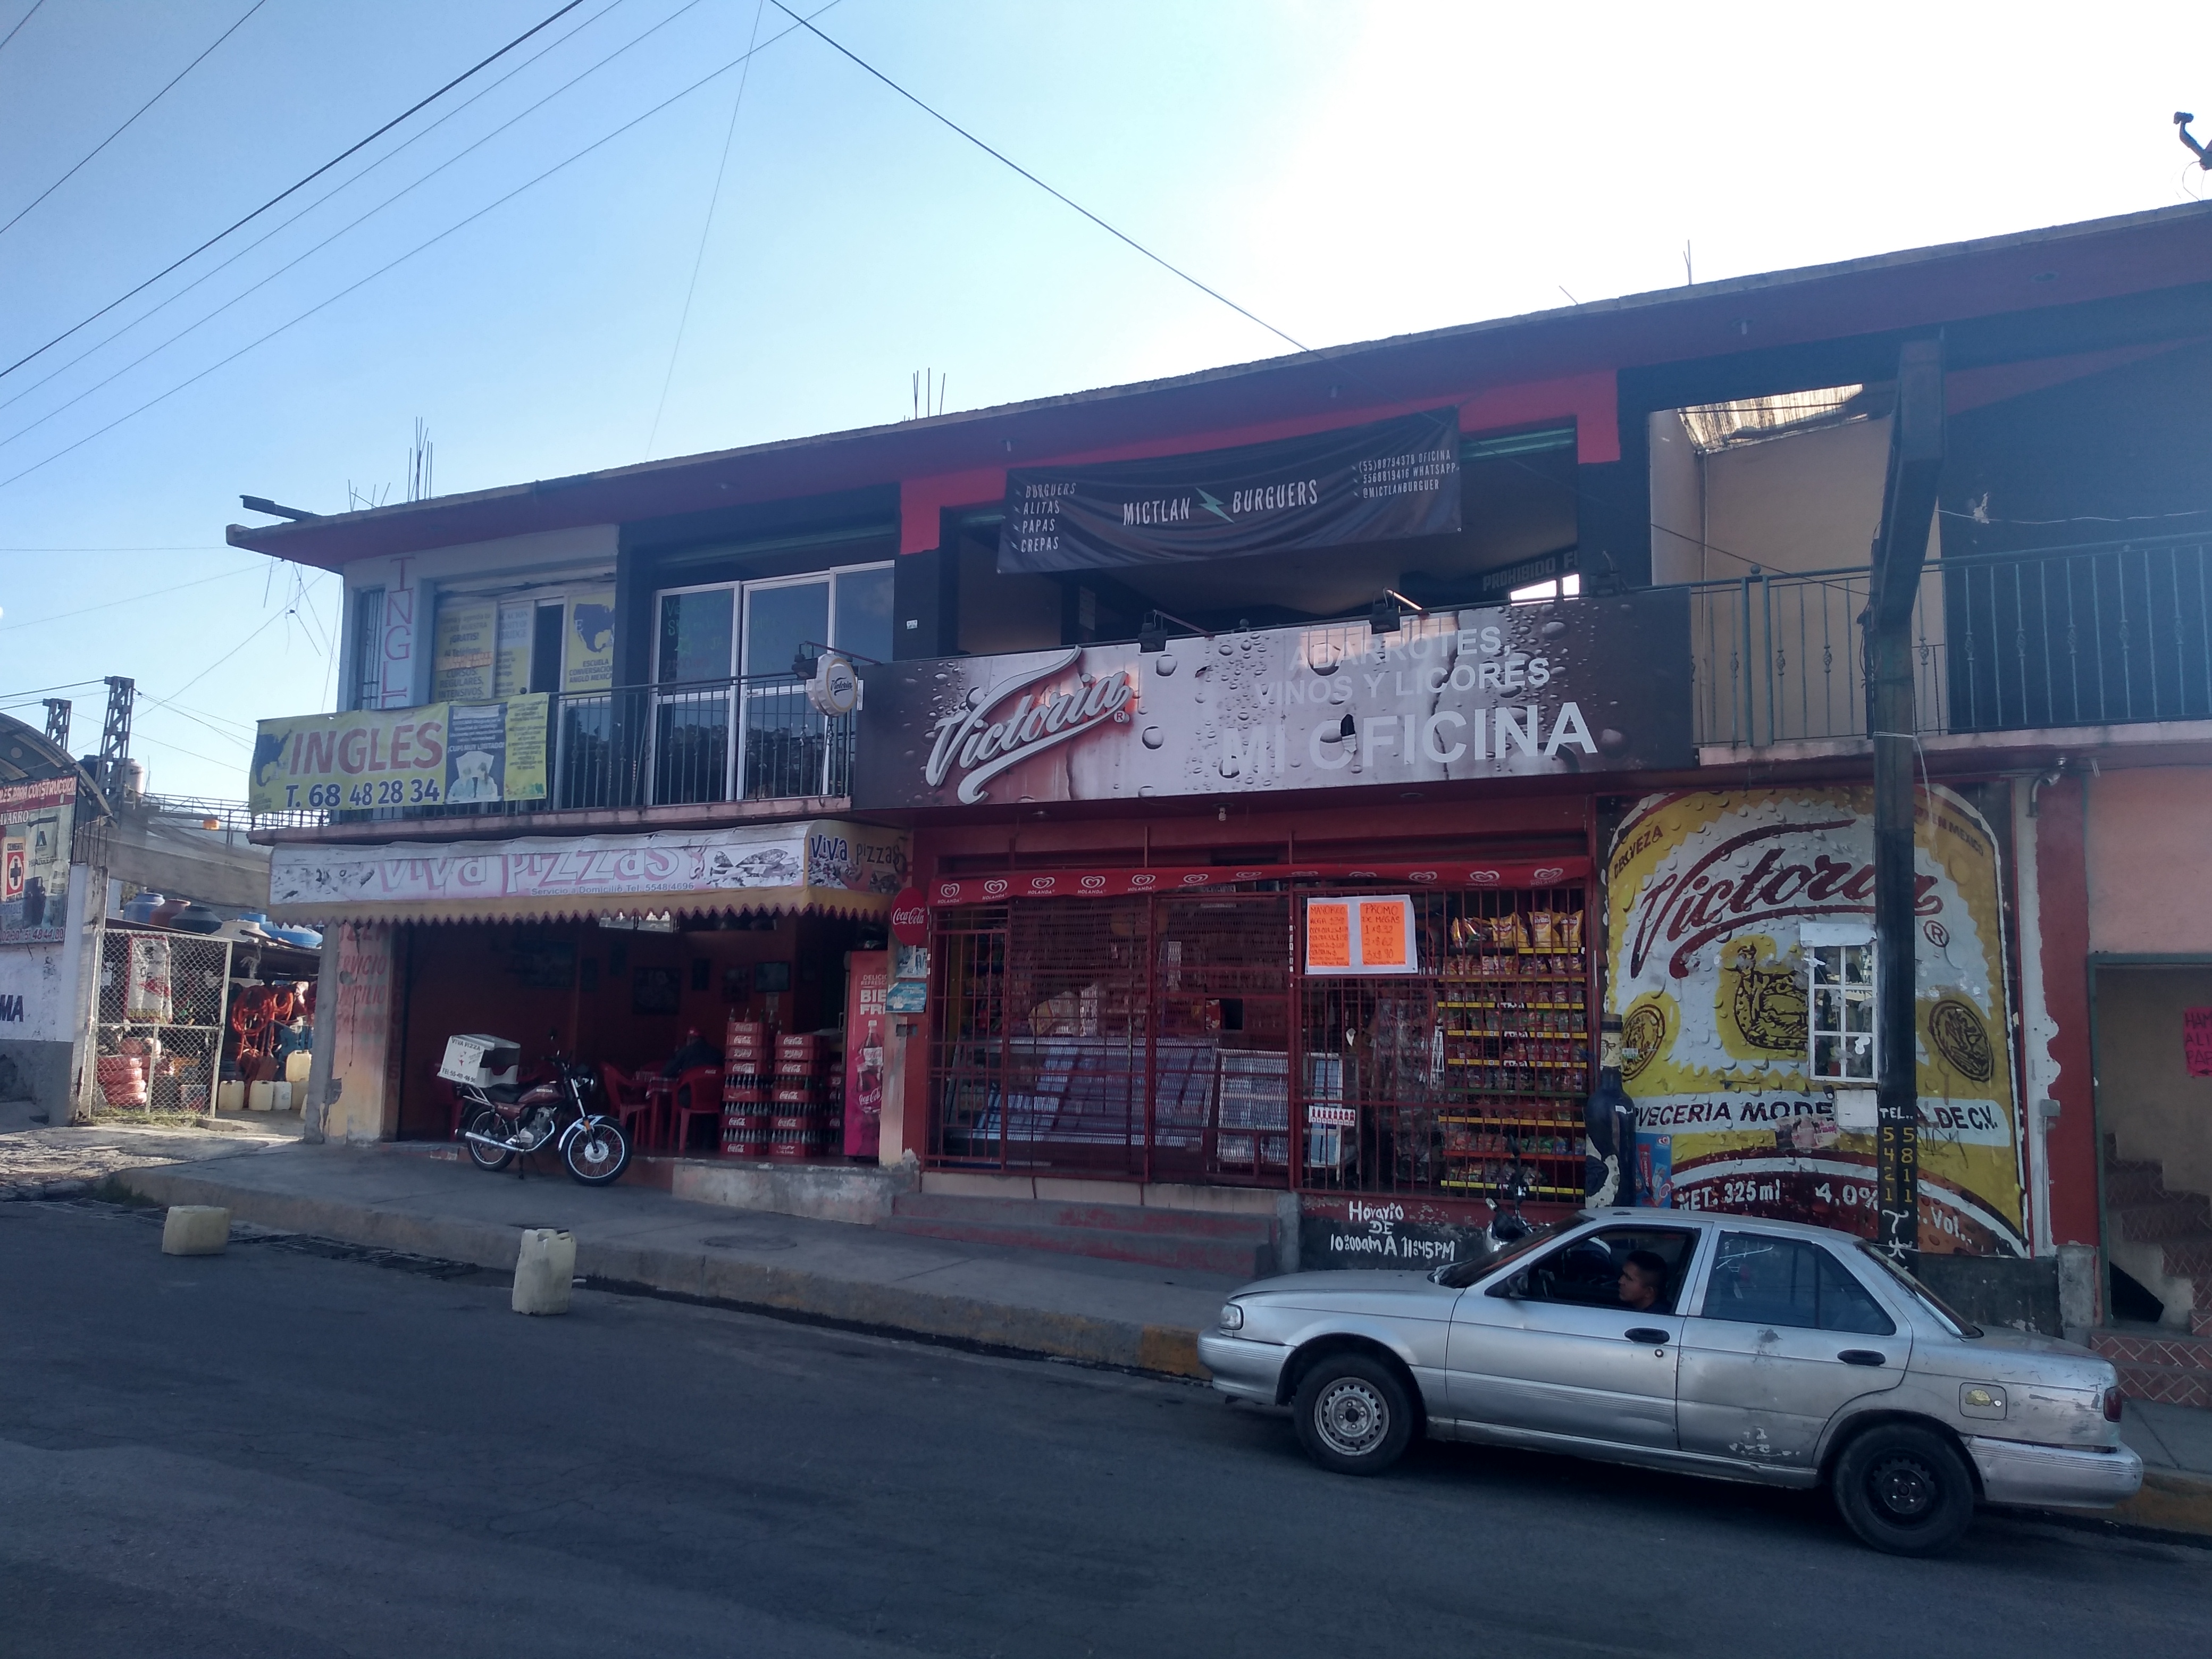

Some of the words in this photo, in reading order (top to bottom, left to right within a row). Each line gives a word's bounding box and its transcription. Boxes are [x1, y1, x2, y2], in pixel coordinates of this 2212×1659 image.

[1419, 450, 1451, 463] OFICINA
[1413, 463, 1455, 476] WHATSAPP
[1026, 483, 1076, 498] BURGUERS
[1363, 479, 1439, 498] @MICTLANBURGUER
[1024, 500, 1060, 515] ALITAS
[1123, 497, 1190, 525] MICTLAN
[1233, 479, 1318, 513] BURGUERS
[1023, 518, 1055, 534] PAPAS
[1021, 537, 1059, 552] CREPAS
[831, 677, 853, 696] Victoria
[1255, 676, 1353, 707] VINOS
[1363, 672, 1385, 698] Y
[1396, 658, 1551, 696] LICORES
[925, 644, 1135, 805] Victoria
[289, 722, 443, 775] INGLES
[1222, 724, 1286, 775] MI
[286, 784, 300, 808] T.
[309, 783, 340, 807] 68
[349, 782, 372, 806] 48
[378, 780, 404, 803] 28
[410, 778, 440, 803] 34
[1614, 825, 1663, 879] CERVEZA
[646, 883, 667, 892] 5548
[893, 907, 925, 925] Coca-Cola
[1311, 906, 1345, 915] MAYOREO
[1363, 903, 1398, 915] PROMO
[860, 990, 886, 1003] BIE
[465, 1042, 480, 1051] PIZZA
[734, 1036, 751, 1044] Coca-Cola
[782, 1064, 802, 1073] Coca-Cola
[780, 1091, 798, 1100] Coca-Cola
[729, 1117, 746, 1126] Coca-Cola
[778, 1119, 797, 1127] Coca-Cola
[1934, 1107, 1969, 1129] DE
[727, 1144, 744, 1153] Coca-Cola
[1349, 1200, 1404, 1222] Horario
[1369, 1220, 1395, 1234] DE
[1384, 1235, 1397, 1256] A
